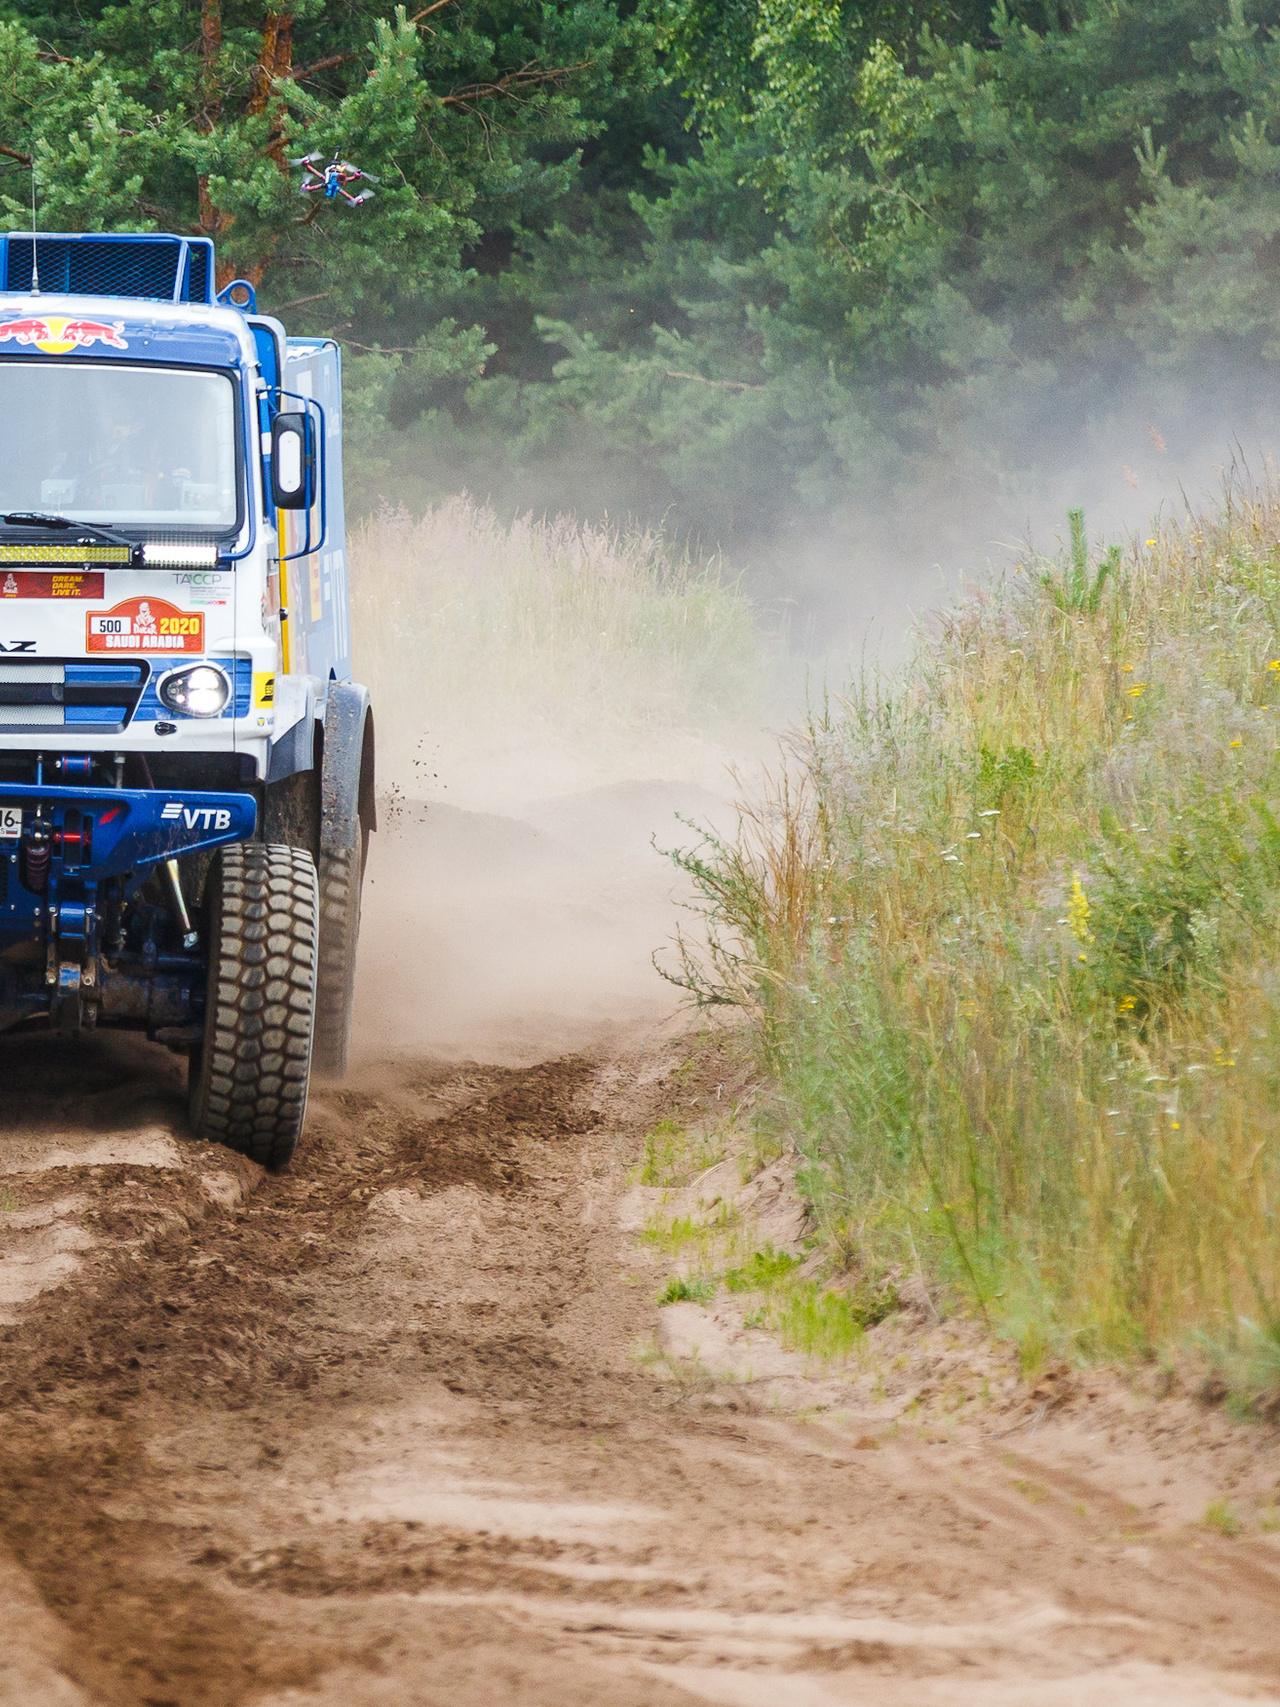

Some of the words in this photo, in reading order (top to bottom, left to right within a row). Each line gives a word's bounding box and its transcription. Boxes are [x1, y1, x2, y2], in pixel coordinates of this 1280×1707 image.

[99, 620, 122, 633] 500
[160, 618, 200, 635] 2020
[105, 635, 140, 648] SAUDI
[141, 635, 185, 649] ARABIA
[183, 808, 231, 830] VTB
